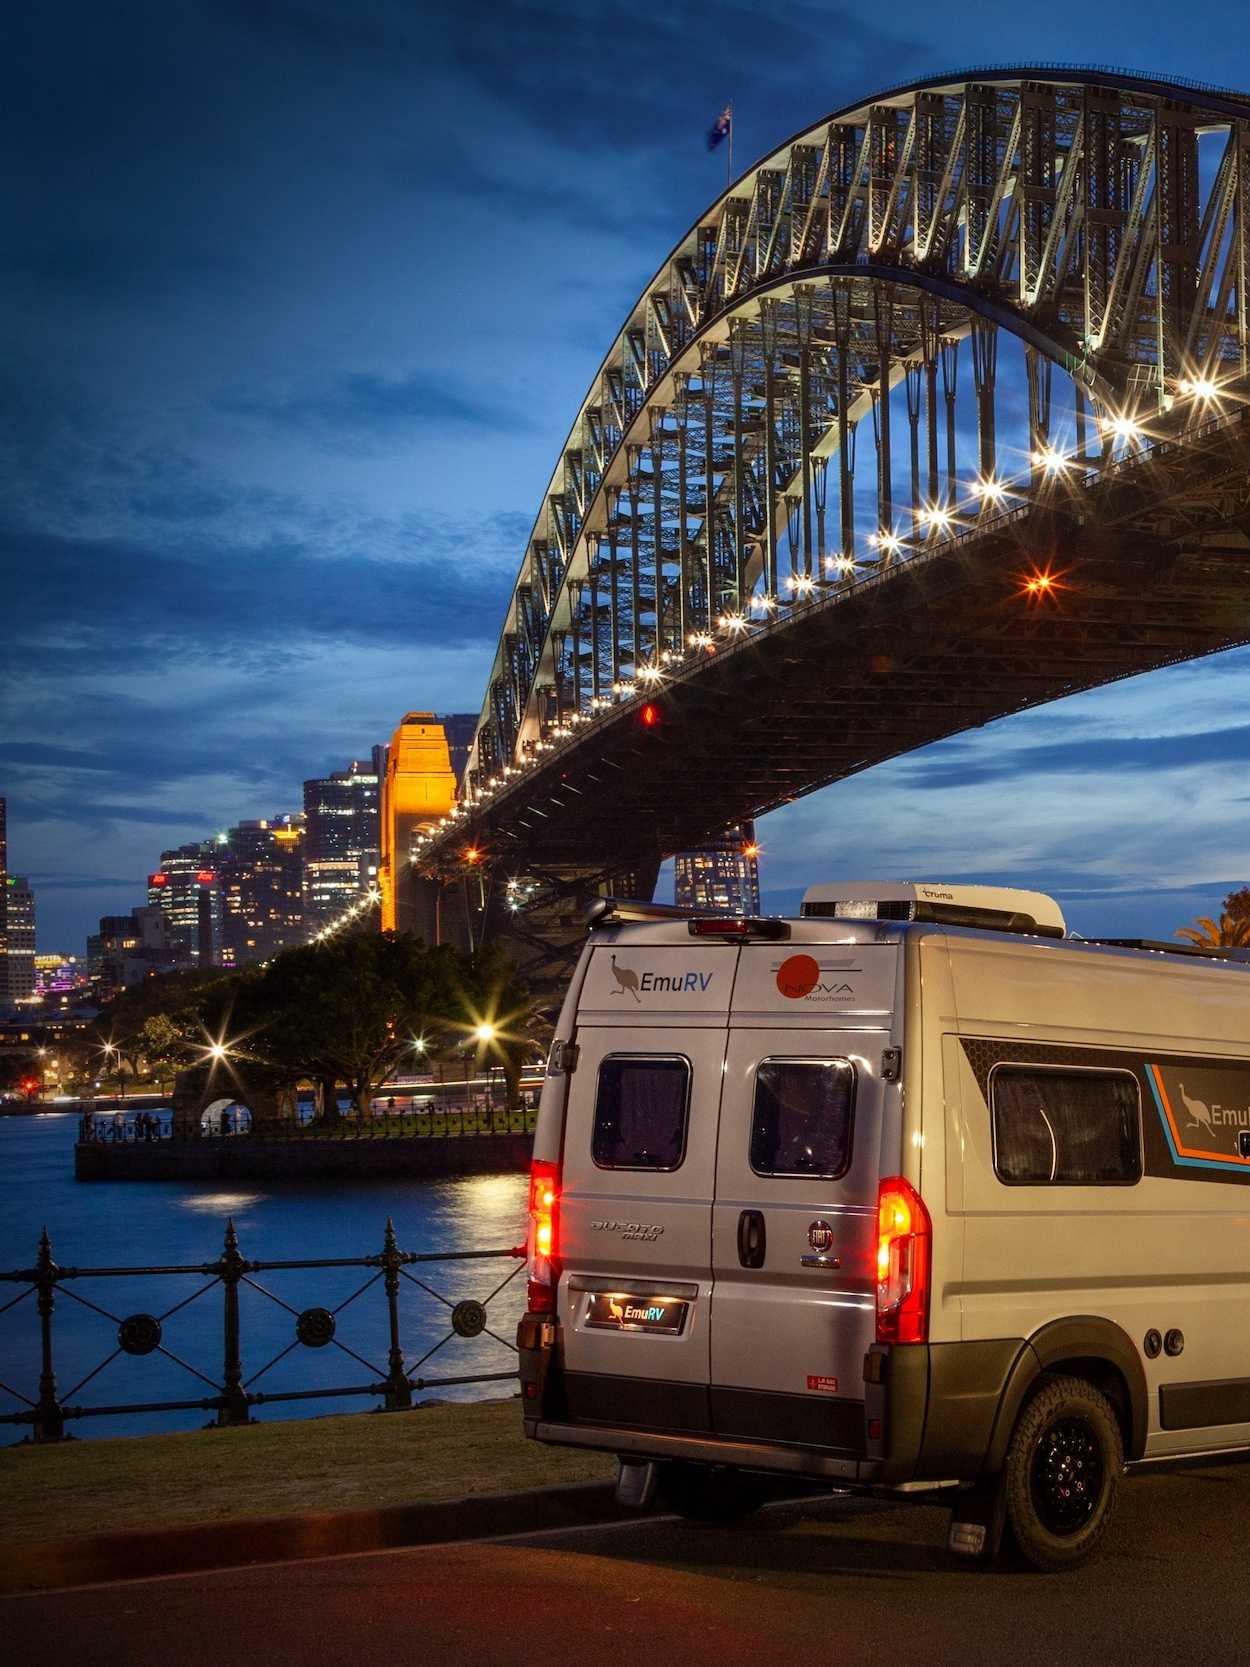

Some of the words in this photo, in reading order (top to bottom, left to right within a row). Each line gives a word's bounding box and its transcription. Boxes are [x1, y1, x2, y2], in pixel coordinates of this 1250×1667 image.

[640, 972, 713, 992] EmuRV
[784, 983, 854, 993] NOVA
[624, 1305, 665, 1321] EmuRV
